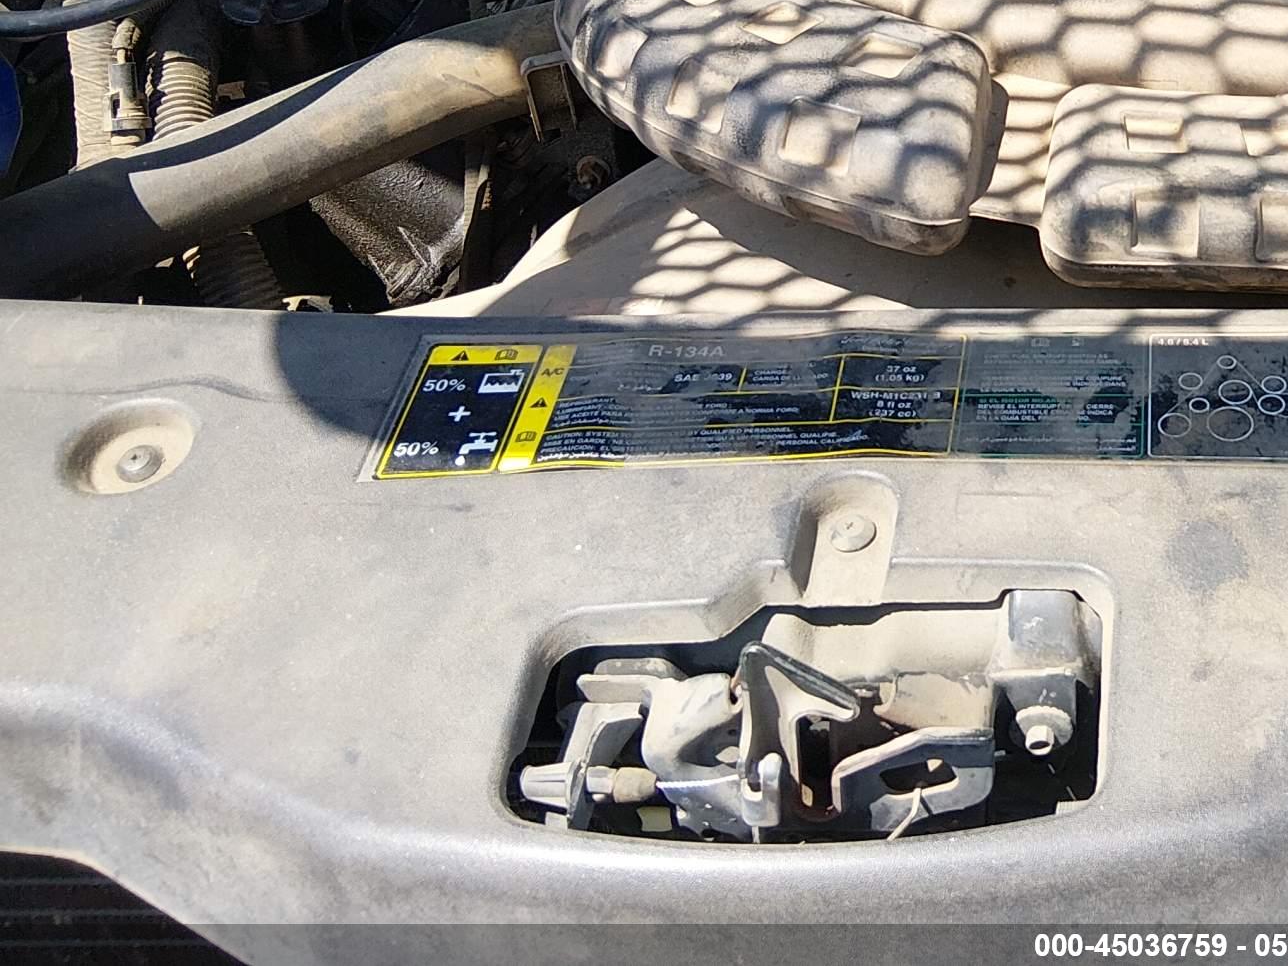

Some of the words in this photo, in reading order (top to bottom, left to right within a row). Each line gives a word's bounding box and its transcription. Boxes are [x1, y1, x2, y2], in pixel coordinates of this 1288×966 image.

[648, 344, 725, 358] R-134A
[540, 367, 564, 377] A/C
[674, 373, 699, 383] SAE
[703, 371, 733, 382] J39
[874, 374, 903, 382] (1.05
[905, 374, 925, 382] kg)
[422, 377, 467, 392] 50%
[876, 399, 884, 407] 8
[886, 399, 895, 408] fl
[897, 400, 912, 408] oz
[897, 409, 917, 418] cc)
[576, 437, 605, 445] GARDE
[392, 440, 440, 458] 50%
